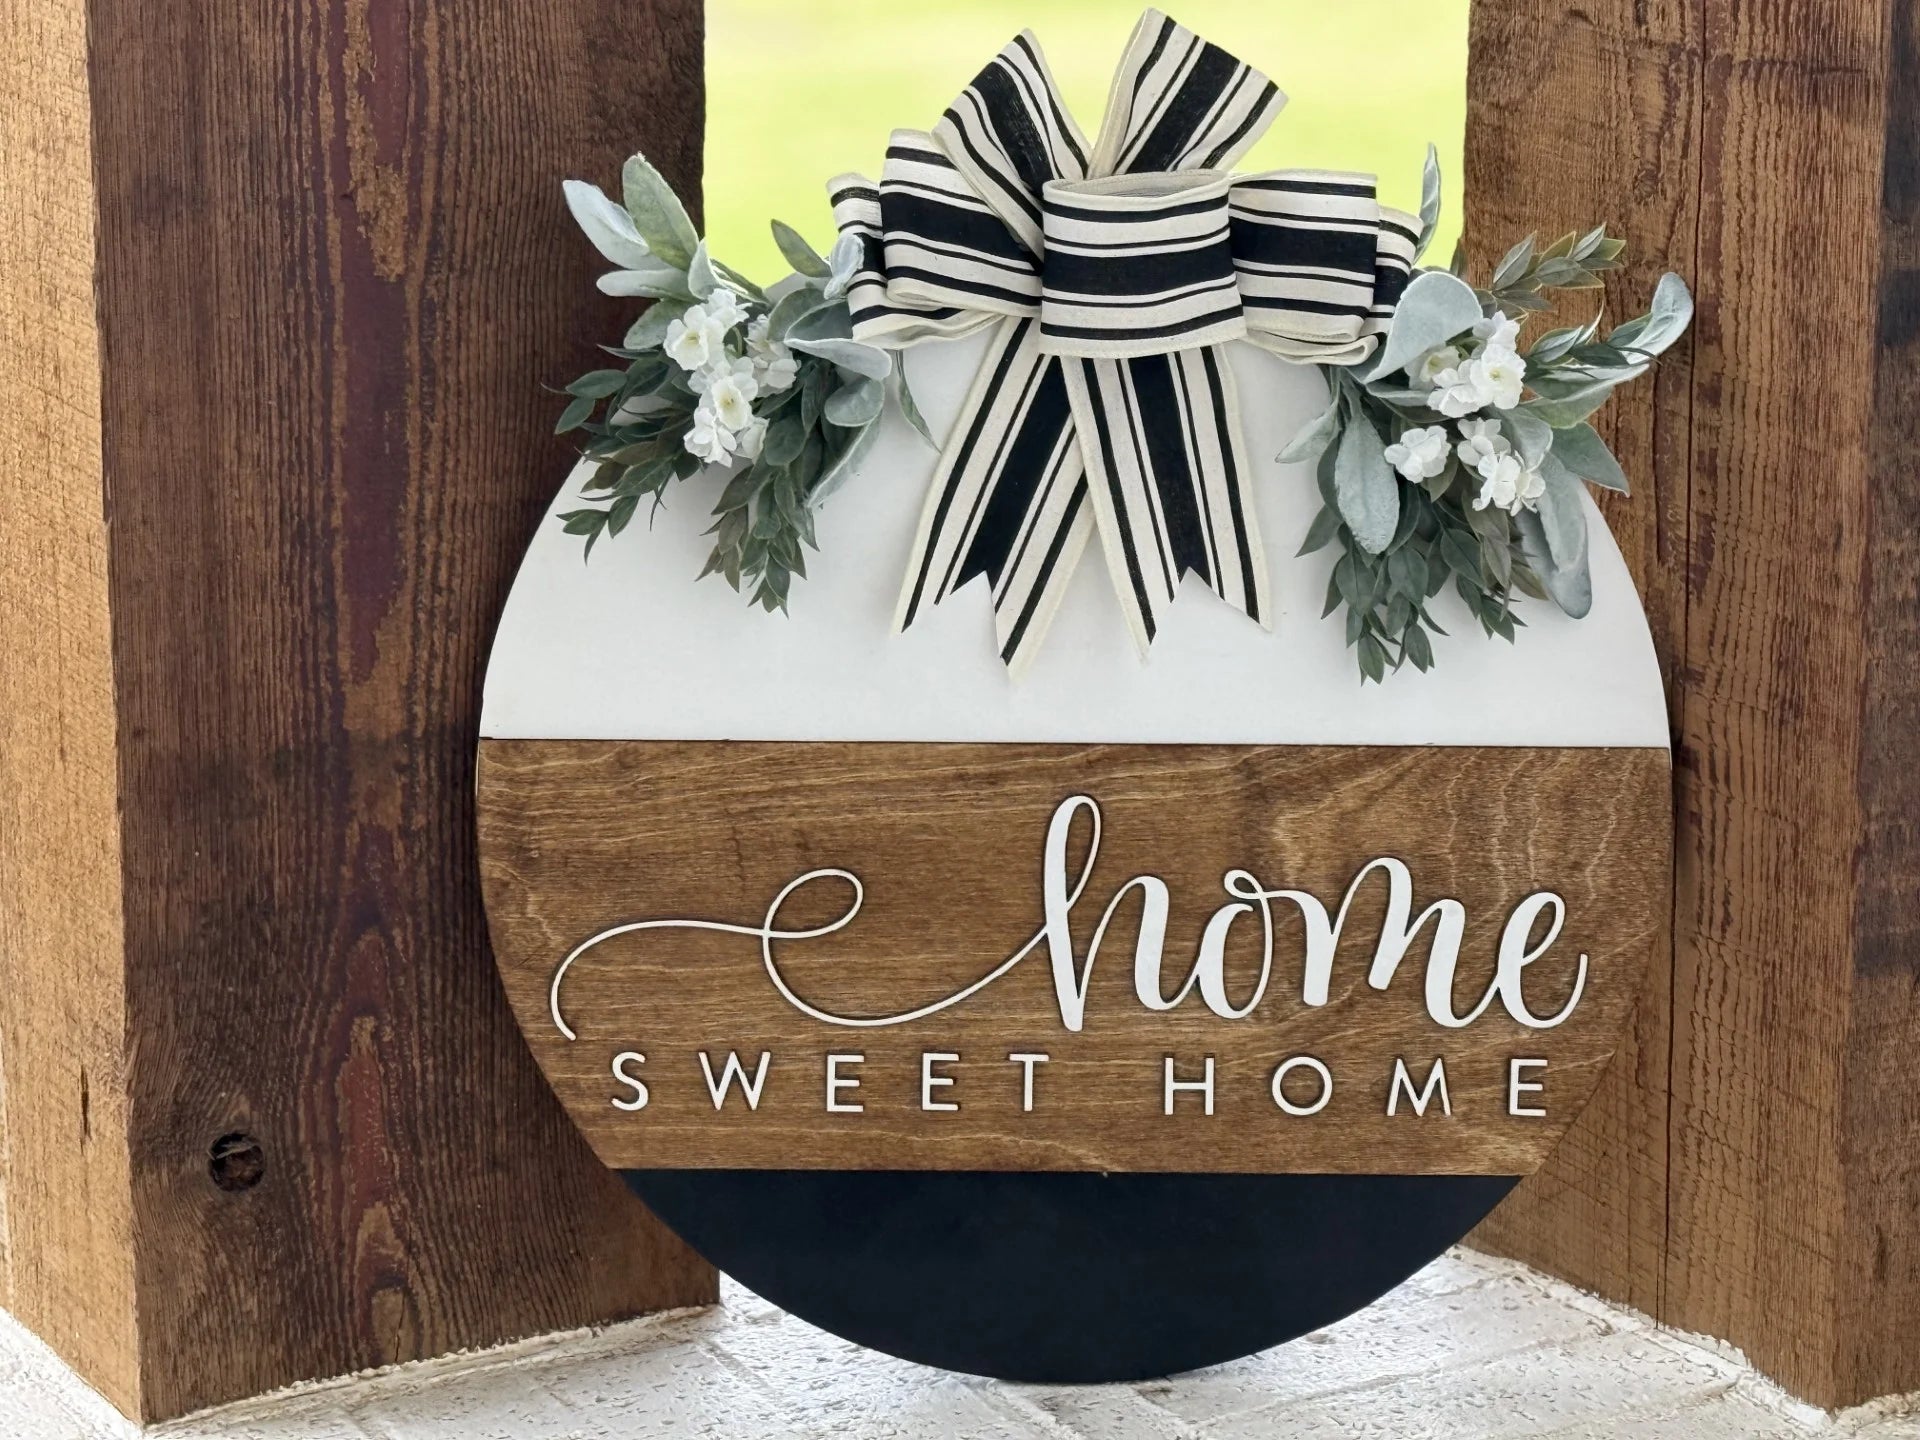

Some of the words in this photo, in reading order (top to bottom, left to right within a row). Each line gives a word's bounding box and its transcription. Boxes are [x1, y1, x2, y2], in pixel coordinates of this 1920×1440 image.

[1036, 795, 1588, 1032] home
[610, 1051, 1050, 1113] SWEET
[1163, 1056, 1549, 1118] HOME
